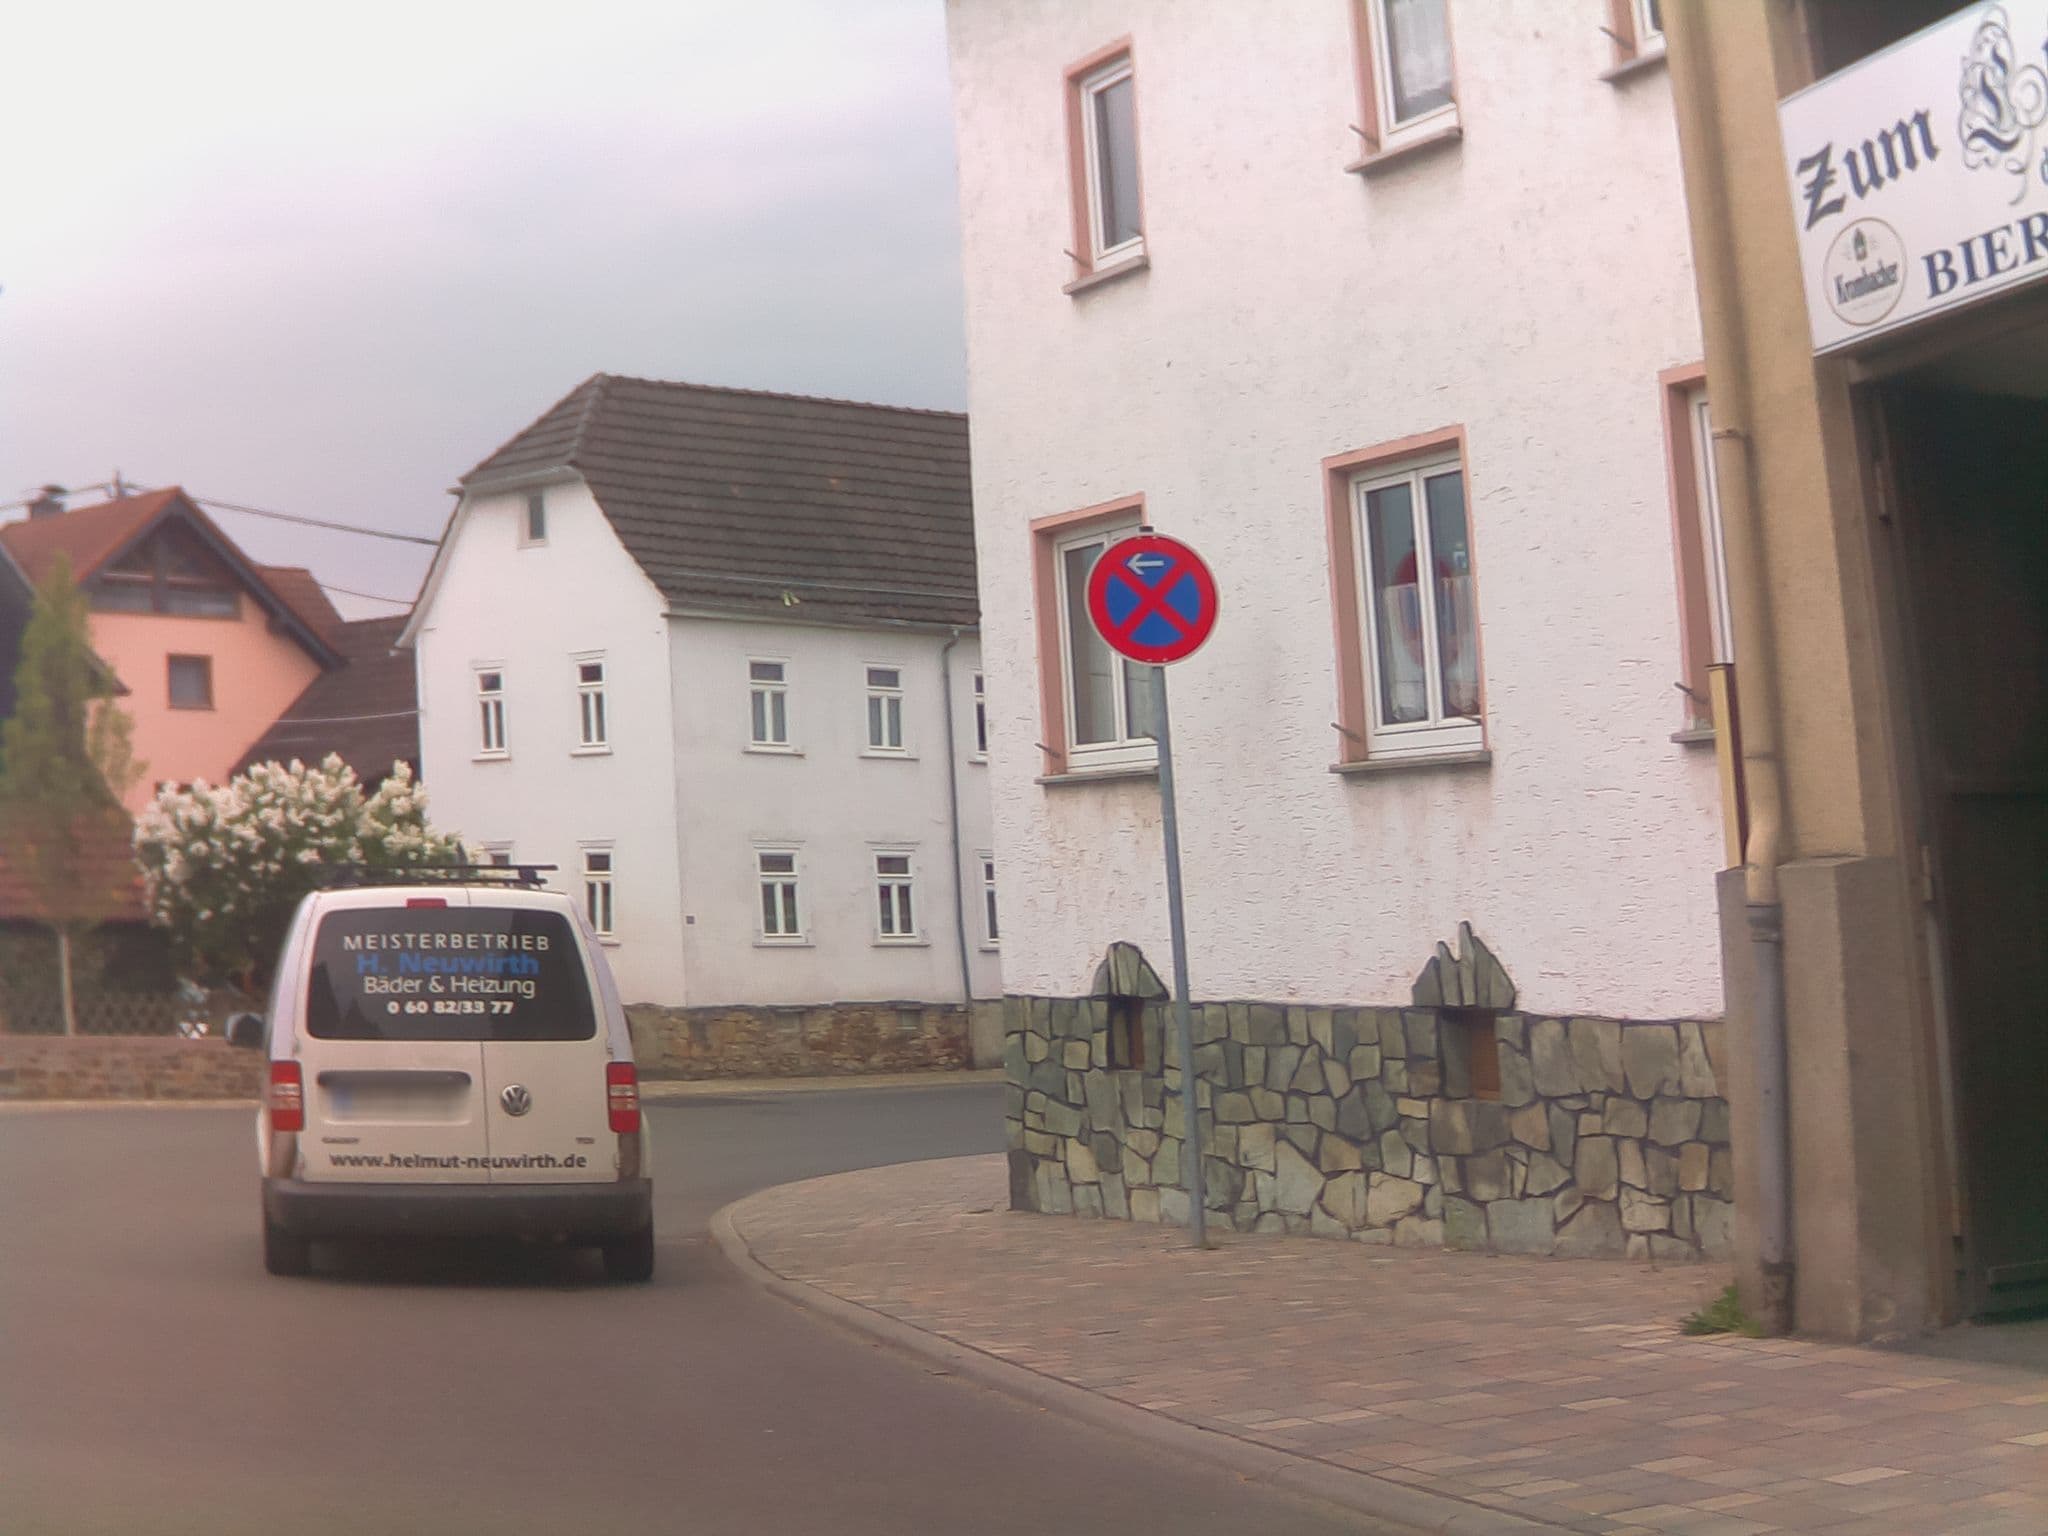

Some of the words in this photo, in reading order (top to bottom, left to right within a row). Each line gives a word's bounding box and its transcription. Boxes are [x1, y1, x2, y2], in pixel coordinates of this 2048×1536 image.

[1796, 109, 1940, 230] Zum
[343, 933, 550, 951] MEISTERBETRIEB
[356, 954, 387, 974] H.
[400, 952, 540, 975] Neuwirth
[363, 976, 423, 994] Bäder
[429, 976, 445, 993] &
[450, 975, 536, 999] Heizung
[387, 1001, 399, 1014] 0
[405, 1001, 428, 1014] 60
[490, 1001, 514, 1014] 77
[330, 1152, 588, 1169] www.helmut-neuwirth.de
